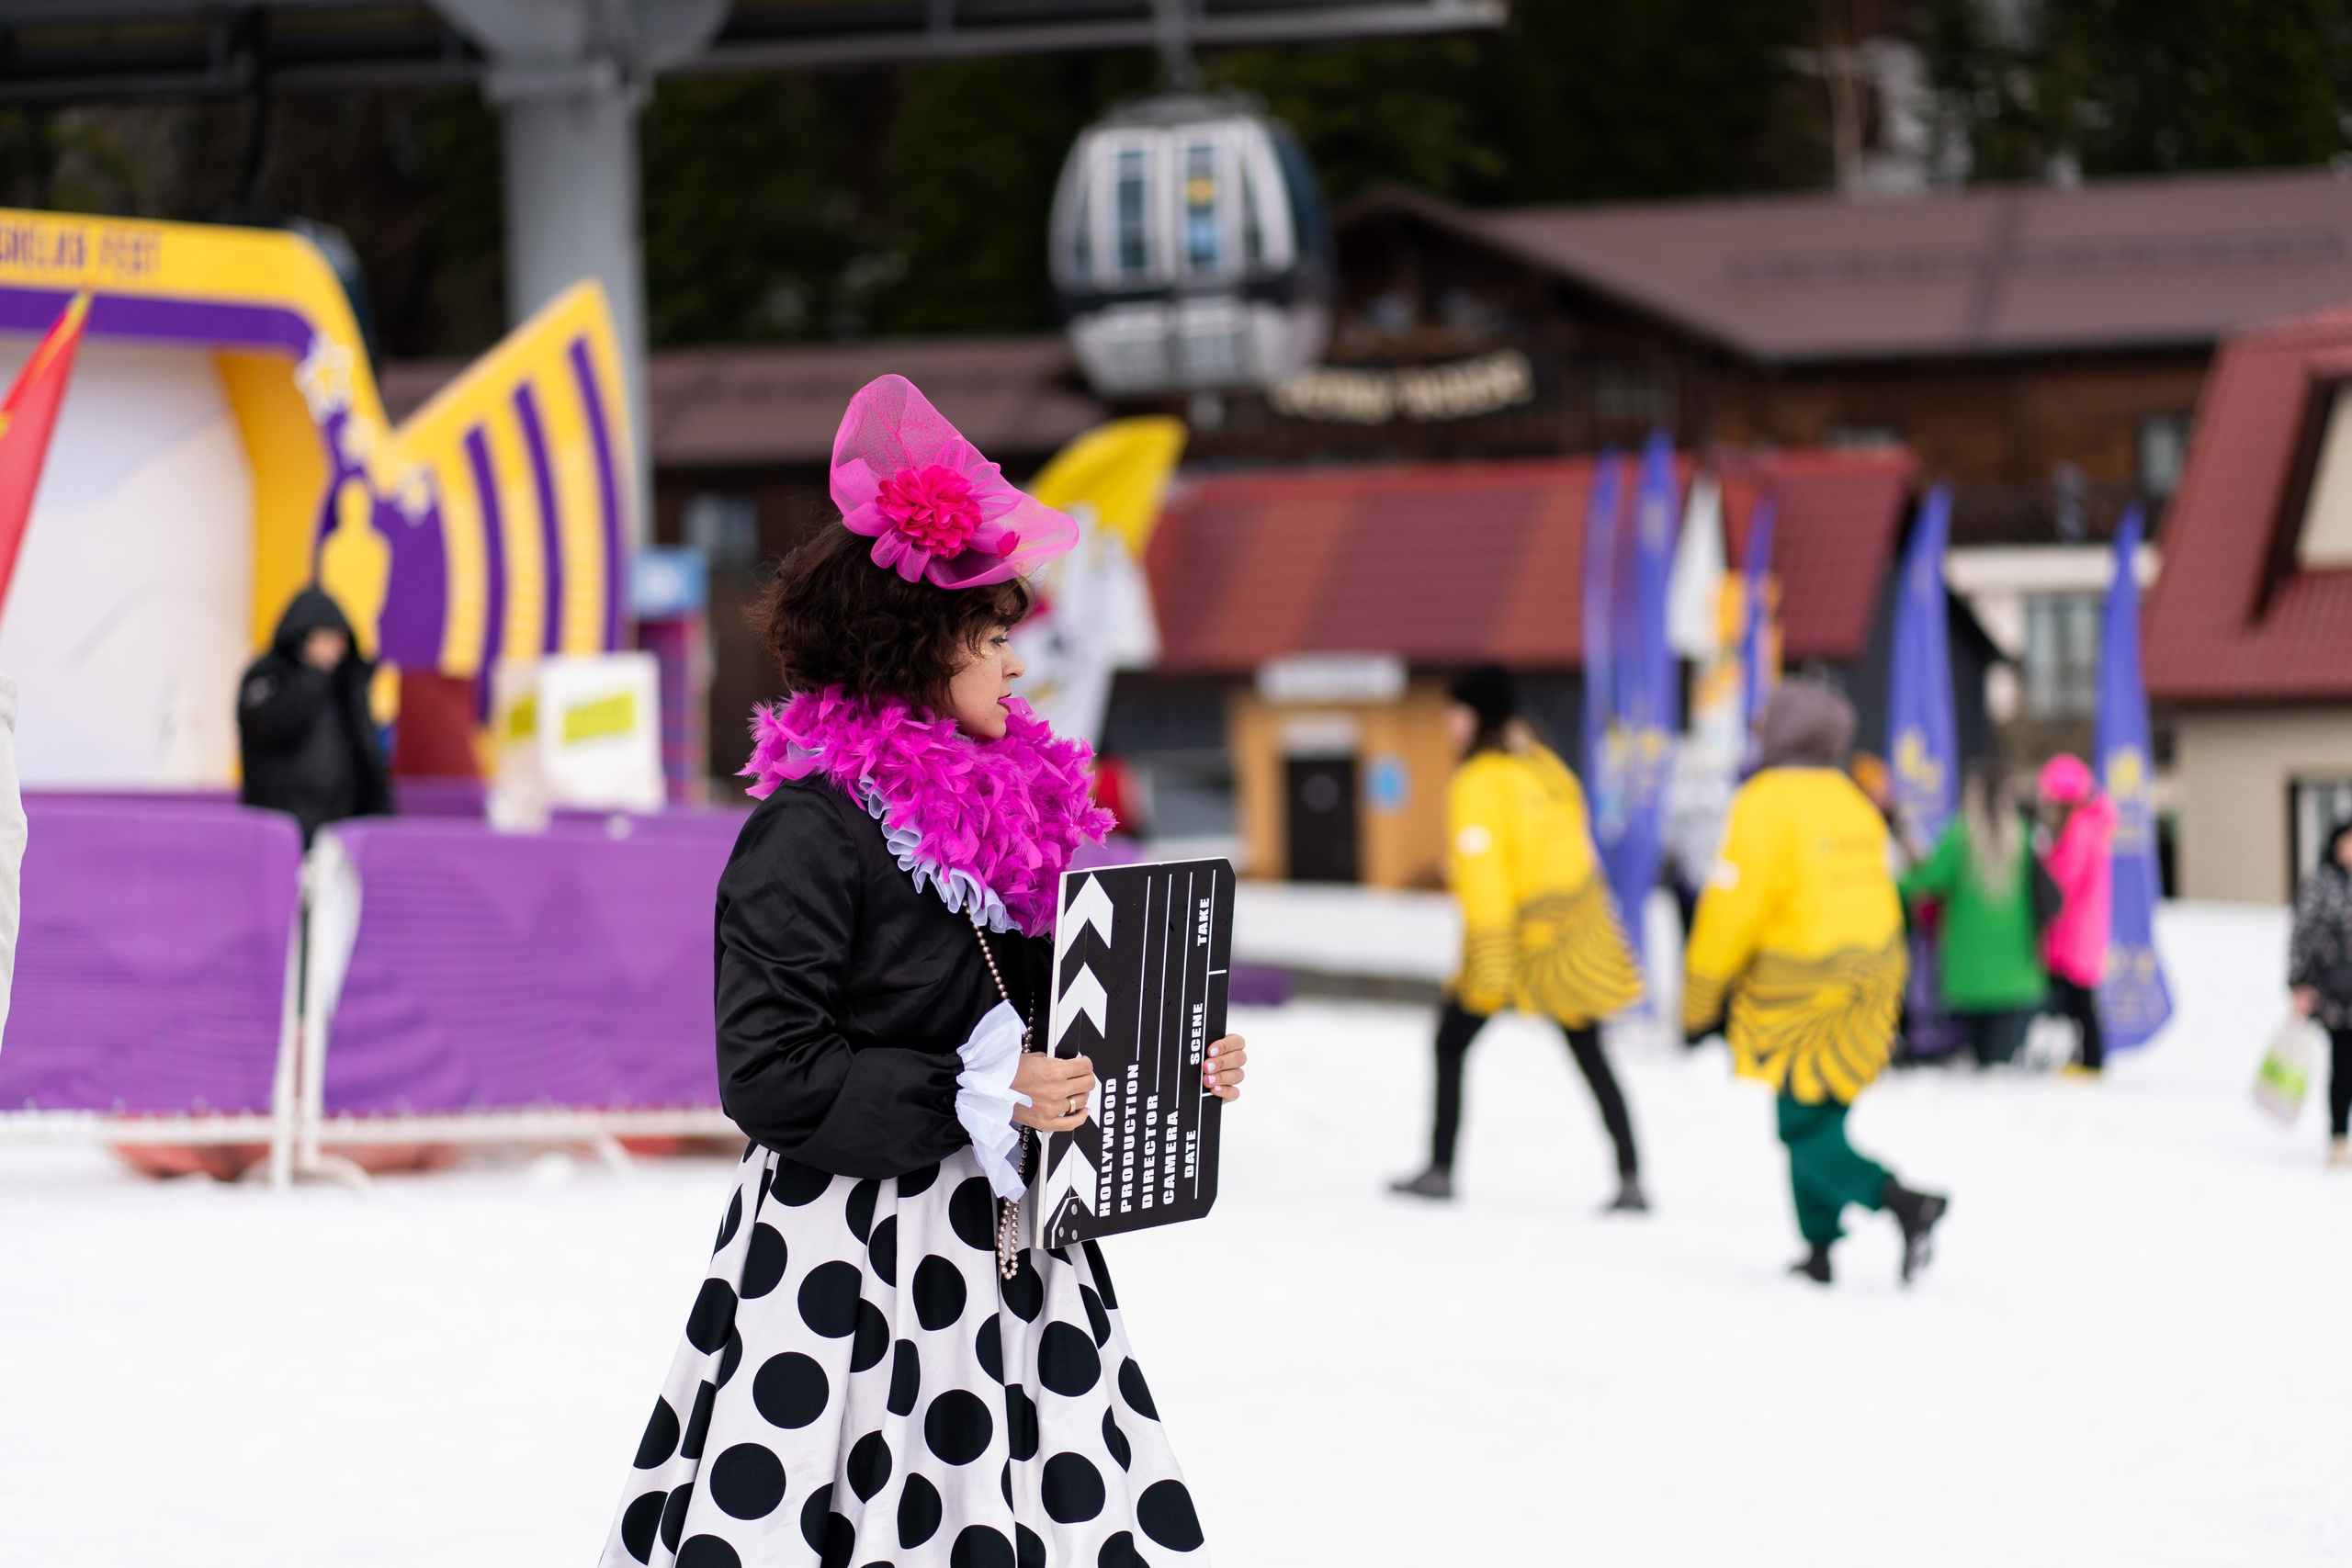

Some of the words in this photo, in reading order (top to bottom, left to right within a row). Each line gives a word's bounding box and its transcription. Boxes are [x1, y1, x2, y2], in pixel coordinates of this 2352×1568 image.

[1196, 897, 1210, 947] TAKE
[1190, 1002, 1204, 1066] SCENE
[1099, 1077, 1117, 1218] HOLLYWOOD
[1120, 1064, 1139, 1213] PRODUCTION
[1141, 1094, 1159, 1210] DIRECTOR
[1162, 1110, 1179, 1205] CAMERA
[1183, 1130, 1196, 1179] DATE
